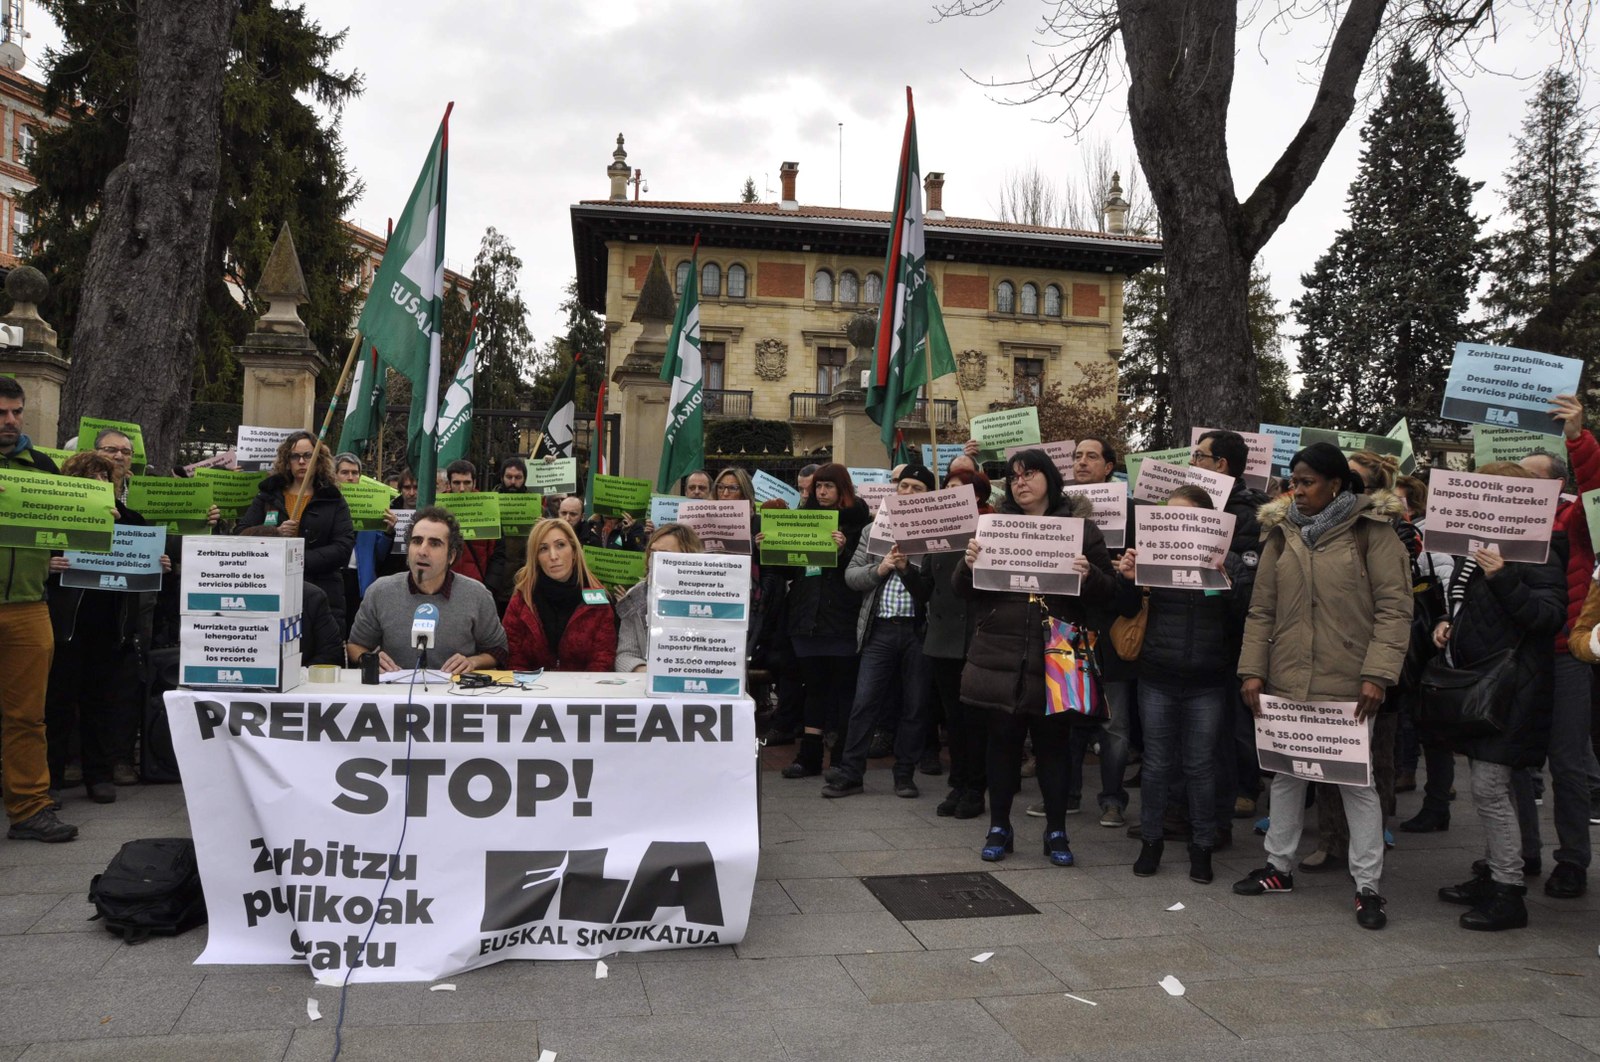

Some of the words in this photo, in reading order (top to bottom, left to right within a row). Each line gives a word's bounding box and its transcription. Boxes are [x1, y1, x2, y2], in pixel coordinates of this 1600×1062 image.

[391, 281, 432, 338] EUSAL
[1467, 350, 1510, 360] Zerbitzu
[1512, 356, 1564, 369] publikoak
[1494, 363, 1531, 374] garatu!
[1467, 374, 1519, 388] Desarrollo
[1522, 382, 1534, 390] de
[1537, 384, 1552, 393] los
[1461, 385, 1506, 398] servicios
[975, 415, 1005, 425] Murrizketa
[1007, 411, 1029, 420] guztiak
[1485, 408, 1519, 424] ELA
[982, 420, 1021, 430] lehengoratu!
[982, 430, 1014, 439] Reversión
[1493, 434, 1543, 442] lehengoratu!
[996, 437, 1023, 445] recortes
[1142, 470, 1172, 482] lanpostu
[0, 474, 54, 485] Negoziazio
[57, 480, 106, 492] kolektiboa
[132, 480, 172, 488] Negoziazio
[1448, 478, 1503, 490] 35.000tik
[1506, 484, 1534, 493] gora
[21, 487, 87, 498] berreskuratu!
[1433, 488, 1479, 501] lanpostu
[1483, 494, 1548, 506] finkatzeke!
[899, 497, 935, 506] 35.000tik
[938, 493, 956, 502] gora
[22, 502, 73, 512] Recuperar
[891, 505, 923, 515] lanpostu
[925, 500, 968, 512] finkatzeke!
[911, 519, 937, 527] 35.000
[940, 514, 973, 524] empleos
[1150, 513, 1198, 521] 35.000tik
[1201, 516, 1220, 524] gora
[1440, 507, 1452, 515] de
[1455, 509, 1495, 521] 35.000
[1498, 515, 1547, 524] empleos
[921, 524, 961, 534] consolidar
[992, 520, 1037, 529] 35.000tik
[1139, 523, 1179, 532] lanpostu
[1182, 524, 1228, 537] finkatzeke!
[1446, 520, 1465, 529] por
[1468, 523, 1525, 535] consolidar
[36, 532, 68, 544] ELA
[117, 530, 156, 538] publikoak
[979, 531, 1019, 539] lanpostu
[1022, 532, 1074, 541] finkatzeke!
[925, 539, 951, 549] ELA
[788, 553, 808, 563] ELA
[999, 548, 1032, 556] 35.000
[1035, 550, 1075, 558] empleos
[1153, 553, 1167, 561] por
[77, 558, 114, 566] servicios
[1009, 559, 1059, 568] consolidar
[678, 569, 726, 577] berreskuratu!
[1172, 570, 1202, 583] ELA
[100, 575, 127, 587] ELA
[1010, 575, 1039, 588] ELA
[221, 597, 246, 608] ELA
[689, 605, 712, 615] ELA
[693, 645, 736, 653] finkatzeke!
[218, 670, 243, 681] ELA
[684, 680, 708, 690] ELA
[1267, 702, 1316, 712] 35.000tik
[1318, 706, 1342, 714] gora
[194, 700, 733, 742] PREKARIETATEARI
[1258, 713, 1297, 722] anpostu
[1300, 715, 1358, 726] finkatzeke!
[1265, 729, 1275, 738] de
[1278, 731, 1313, 741] 35.000
[1316, 735, 1360, 745] empleos
[1289, 744, 1342, 755] consolidar
[1292, 760, 1324, 776] ELA
[331, 757, 594, 818] STOP!
[250, 837, 417, 881] Zrbitzu
[480, 841, 725, 932] ELA
[479, 925, 568, 956] EUSKAL
[576, 924, 720, 947] SINDIKATUA
